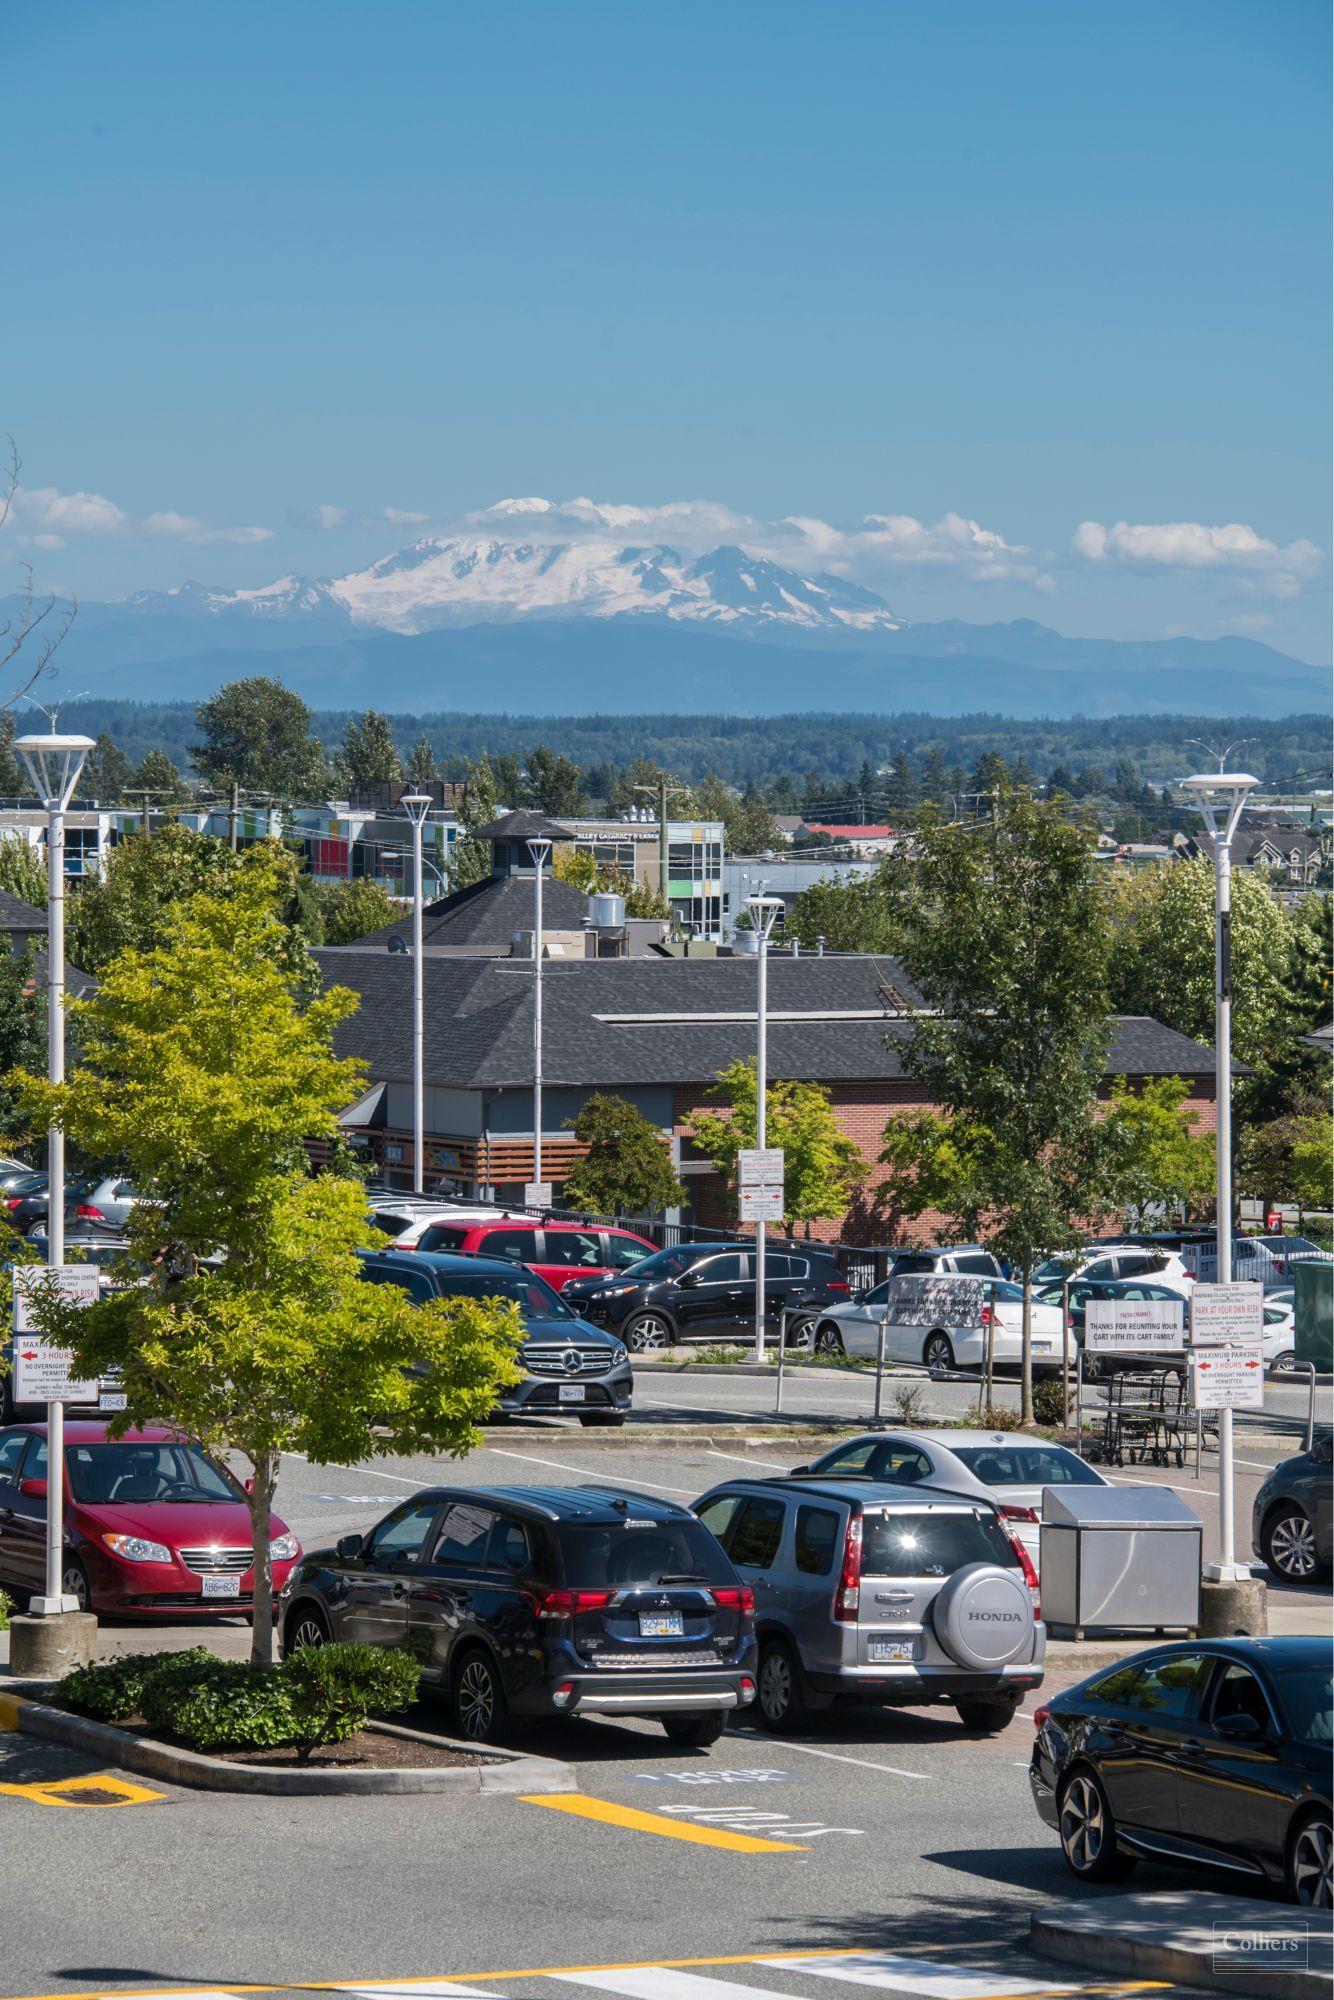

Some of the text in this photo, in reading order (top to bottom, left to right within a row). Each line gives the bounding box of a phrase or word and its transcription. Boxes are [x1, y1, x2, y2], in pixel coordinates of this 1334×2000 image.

[1195, 1304, 1260, 1314] PARK AT YOUR OWN RISK
[1161, 1322, 1178, 1330] YOUR
[1093, 1333, 1109, 1341] CART
[1110, 1333, 1125, 1341] WITH
[48, 1352, 75, 1360] HOURS
[1220, 1361, 1242, 1369] HOURS
[968, 1612, 1023, 1622] HONDA
[664, 1769, 788, 1779] HOUR
